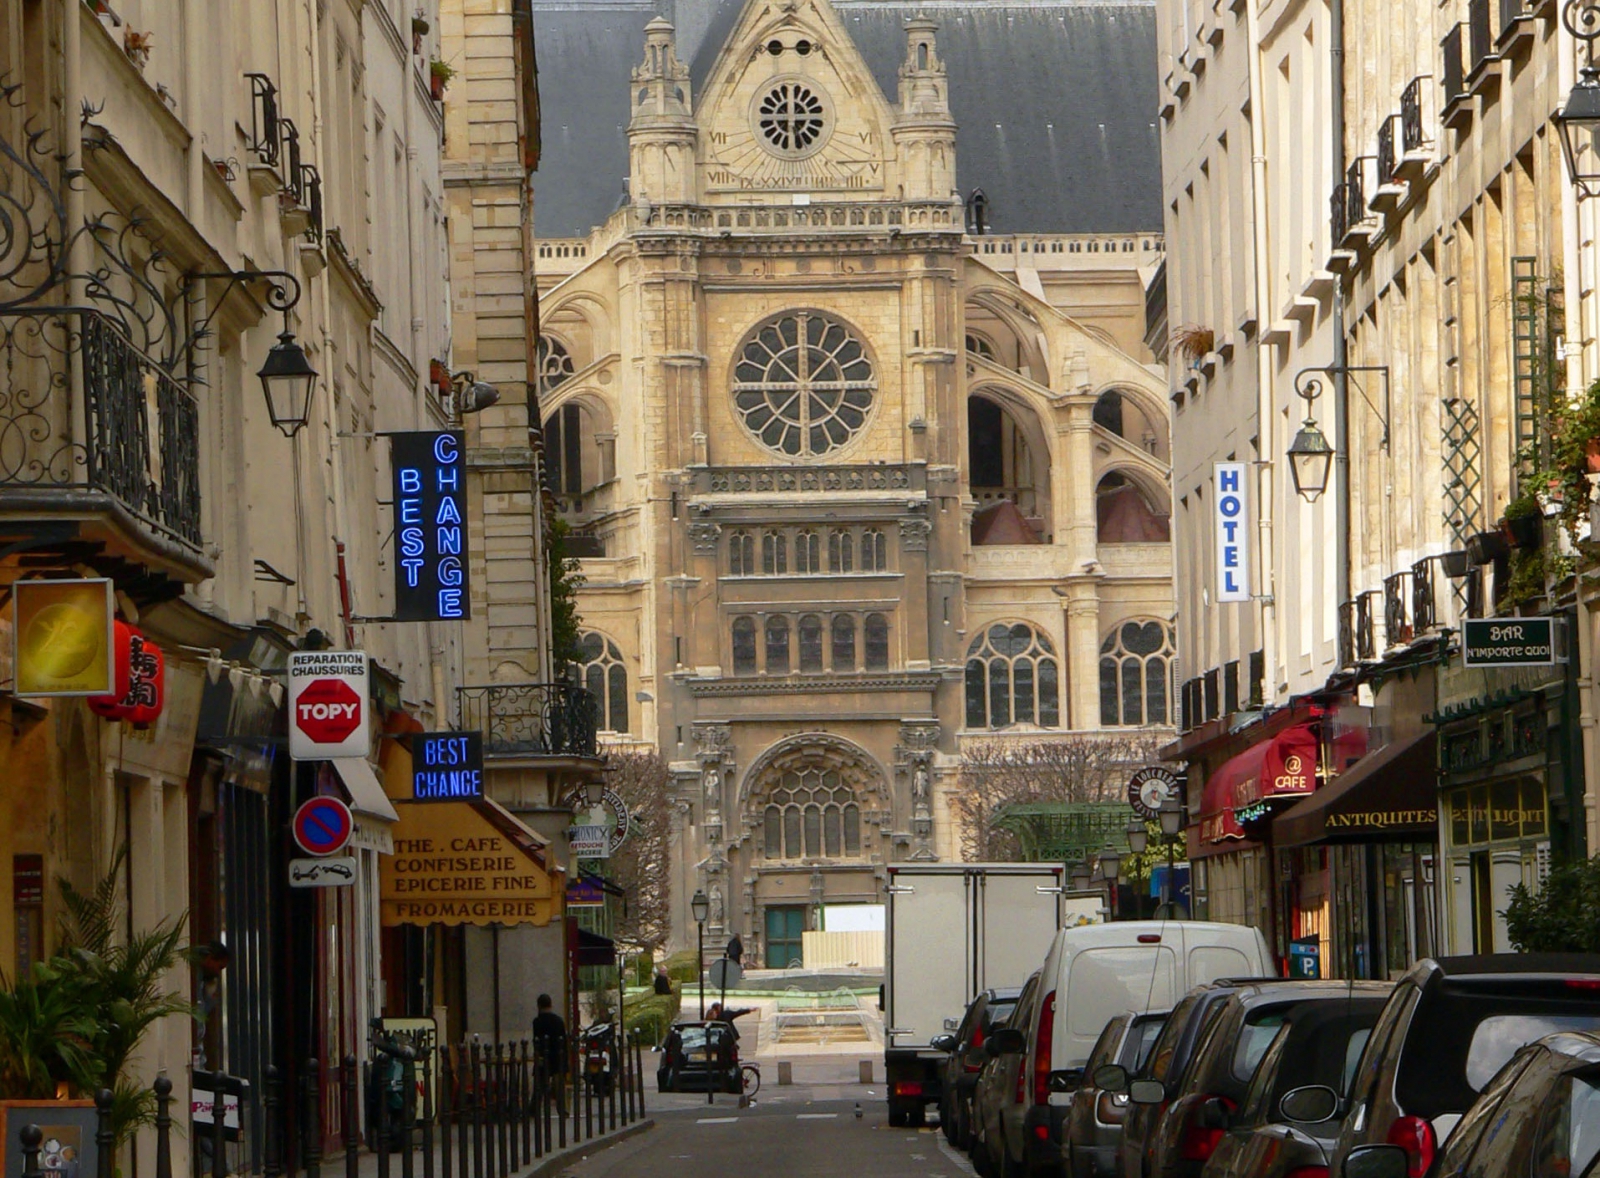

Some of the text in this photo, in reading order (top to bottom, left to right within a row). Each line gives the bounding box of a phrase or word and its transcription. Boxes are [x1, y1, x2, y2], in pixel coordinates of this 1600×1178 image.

[859, 132, 872, 145] VI
[869, 163, 879, 174] V
[401, 468, 424, 587] BEST
[434, 434, 462, 617] CHANGE
[1219, 470, 1240, 592] HOTEL
[1490, 625, 1525, 641] BAR
[293, 654, 363, 666] REPARATION
[1467, 645, 1550, 659] N'IMPORTE QUOI
[292, 665, 364, 677] CHAUSSURES
[299, 703, 358, 720] TOPY
[425, 737, 468, 766] BEST
[1285, 755, 1302, 774] @
[415, 770, 481, 798] CHANGE
[1275, 776, 1306, 788] CAFE
[1325, 809, 1437, 828] ANTIQUITES
[394, 839, 434, 853] THE
[451, 837, 502, 852] CAFE
[394, 857, 515, 873] CONFISERIE
[394, 876, 537, 892] EPICERIE FINE
[395, 902, 537, 917] FROMAGERIE
[1303, 957, 1314, 974] P
